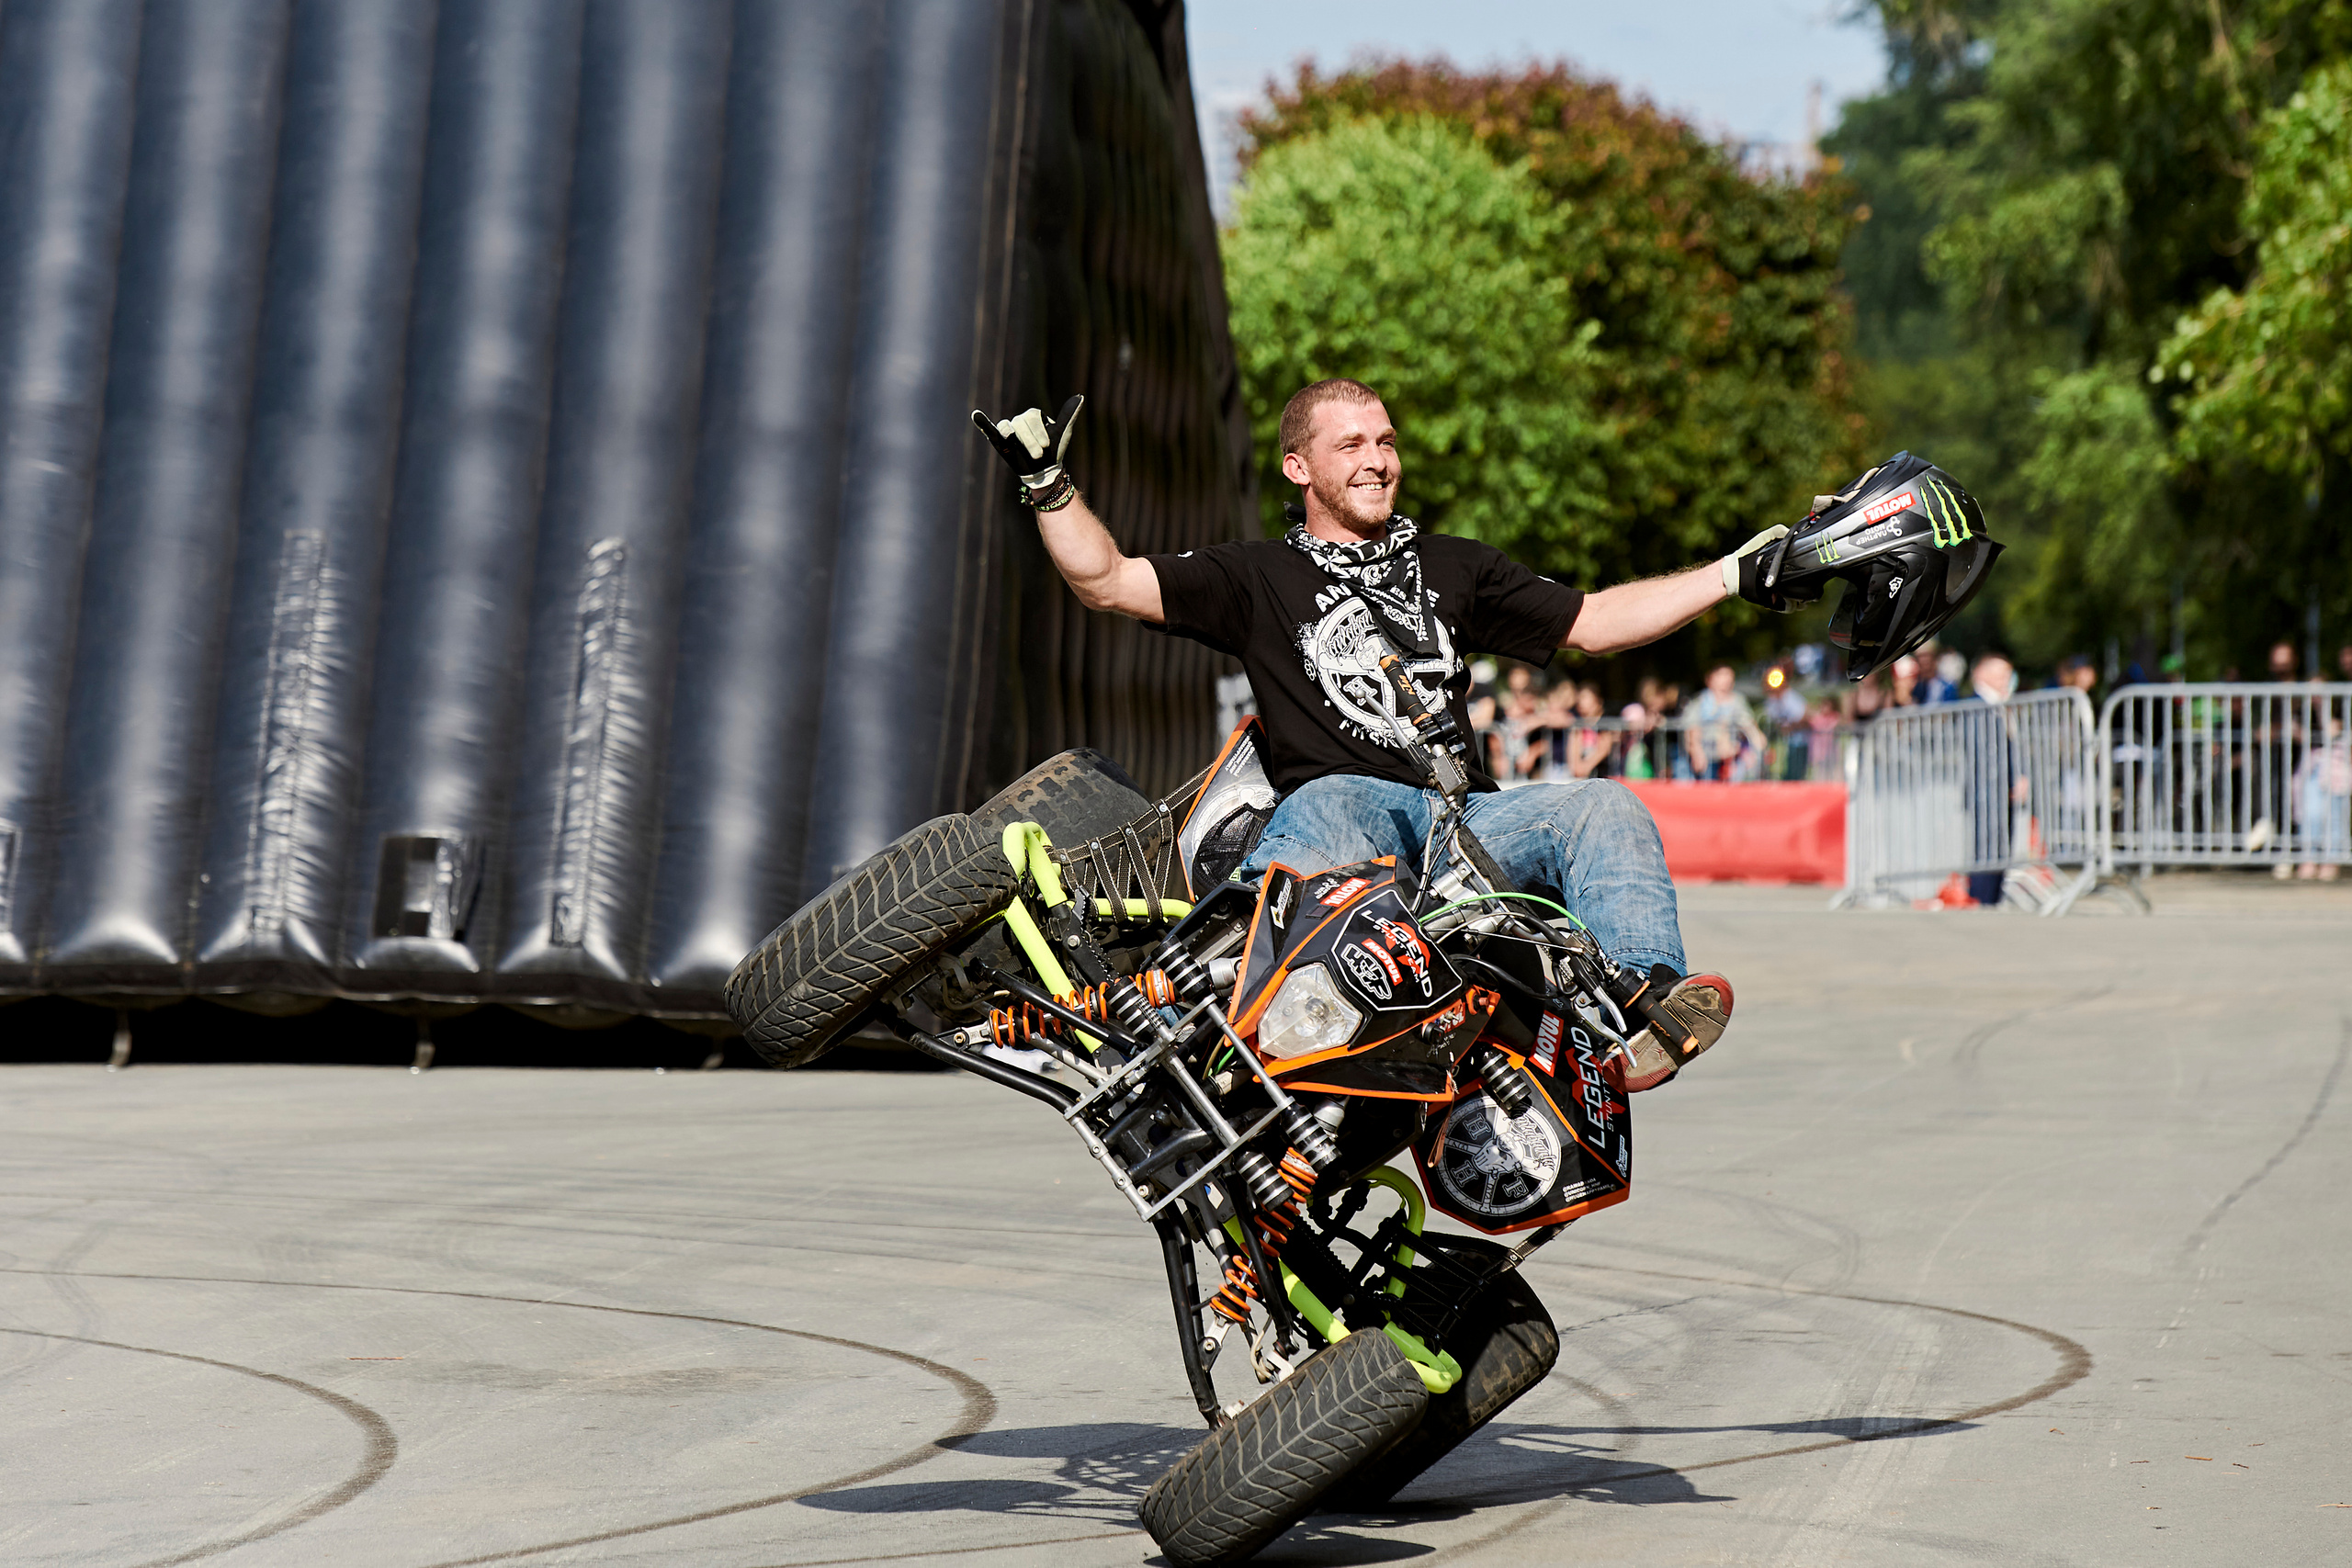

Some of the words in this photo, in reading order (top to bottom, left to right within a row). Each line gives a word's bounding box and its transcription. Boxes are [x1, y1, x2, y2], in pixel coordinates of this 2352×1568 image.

[1866, 493, 1912, 521] MOTUL
[1856, 530, 1888, 546] ПАРТНЕР
[1324, 879, 1366, 905] MOTUL
[1361, 909, 1432, 998] LEGEND
[1365, 942, 1401, 983] MOTUL
[1373, 924, 1407, 950] STUNT
[1406, 950, 1420, 983] TEAM
[1533, 1013, 1560, 1072] MOTUL
[1570, 1026, 1606, 1149] LEGEND
[1602, 1088, 1614, 1133] STUNT
